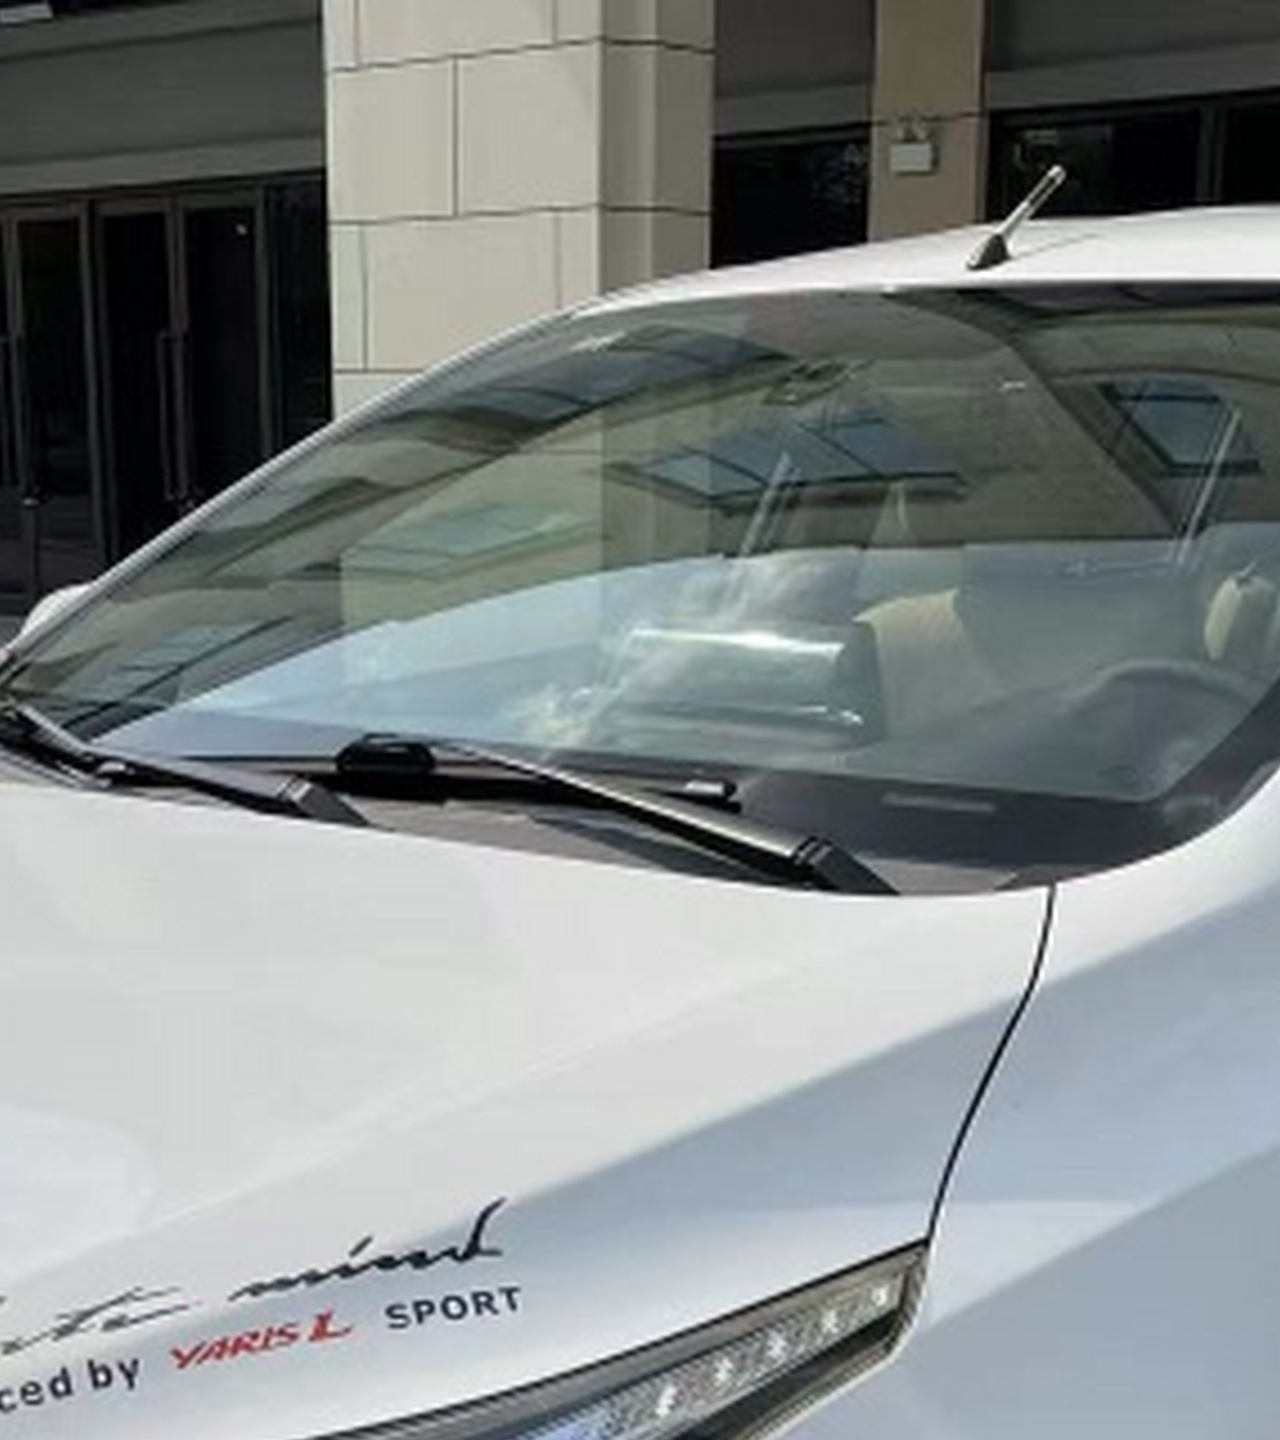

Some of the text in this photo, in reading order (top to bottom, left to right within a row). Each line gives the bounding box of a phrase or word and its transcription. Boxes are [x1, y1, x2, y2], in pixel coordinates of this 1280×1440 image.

[227, 1197, 507, 1301] mind
[90, 1355, 142, 1394] by
[170, 1331, 299, 1370] YARIS
[385, 1286, 522, 1331] SPORT
